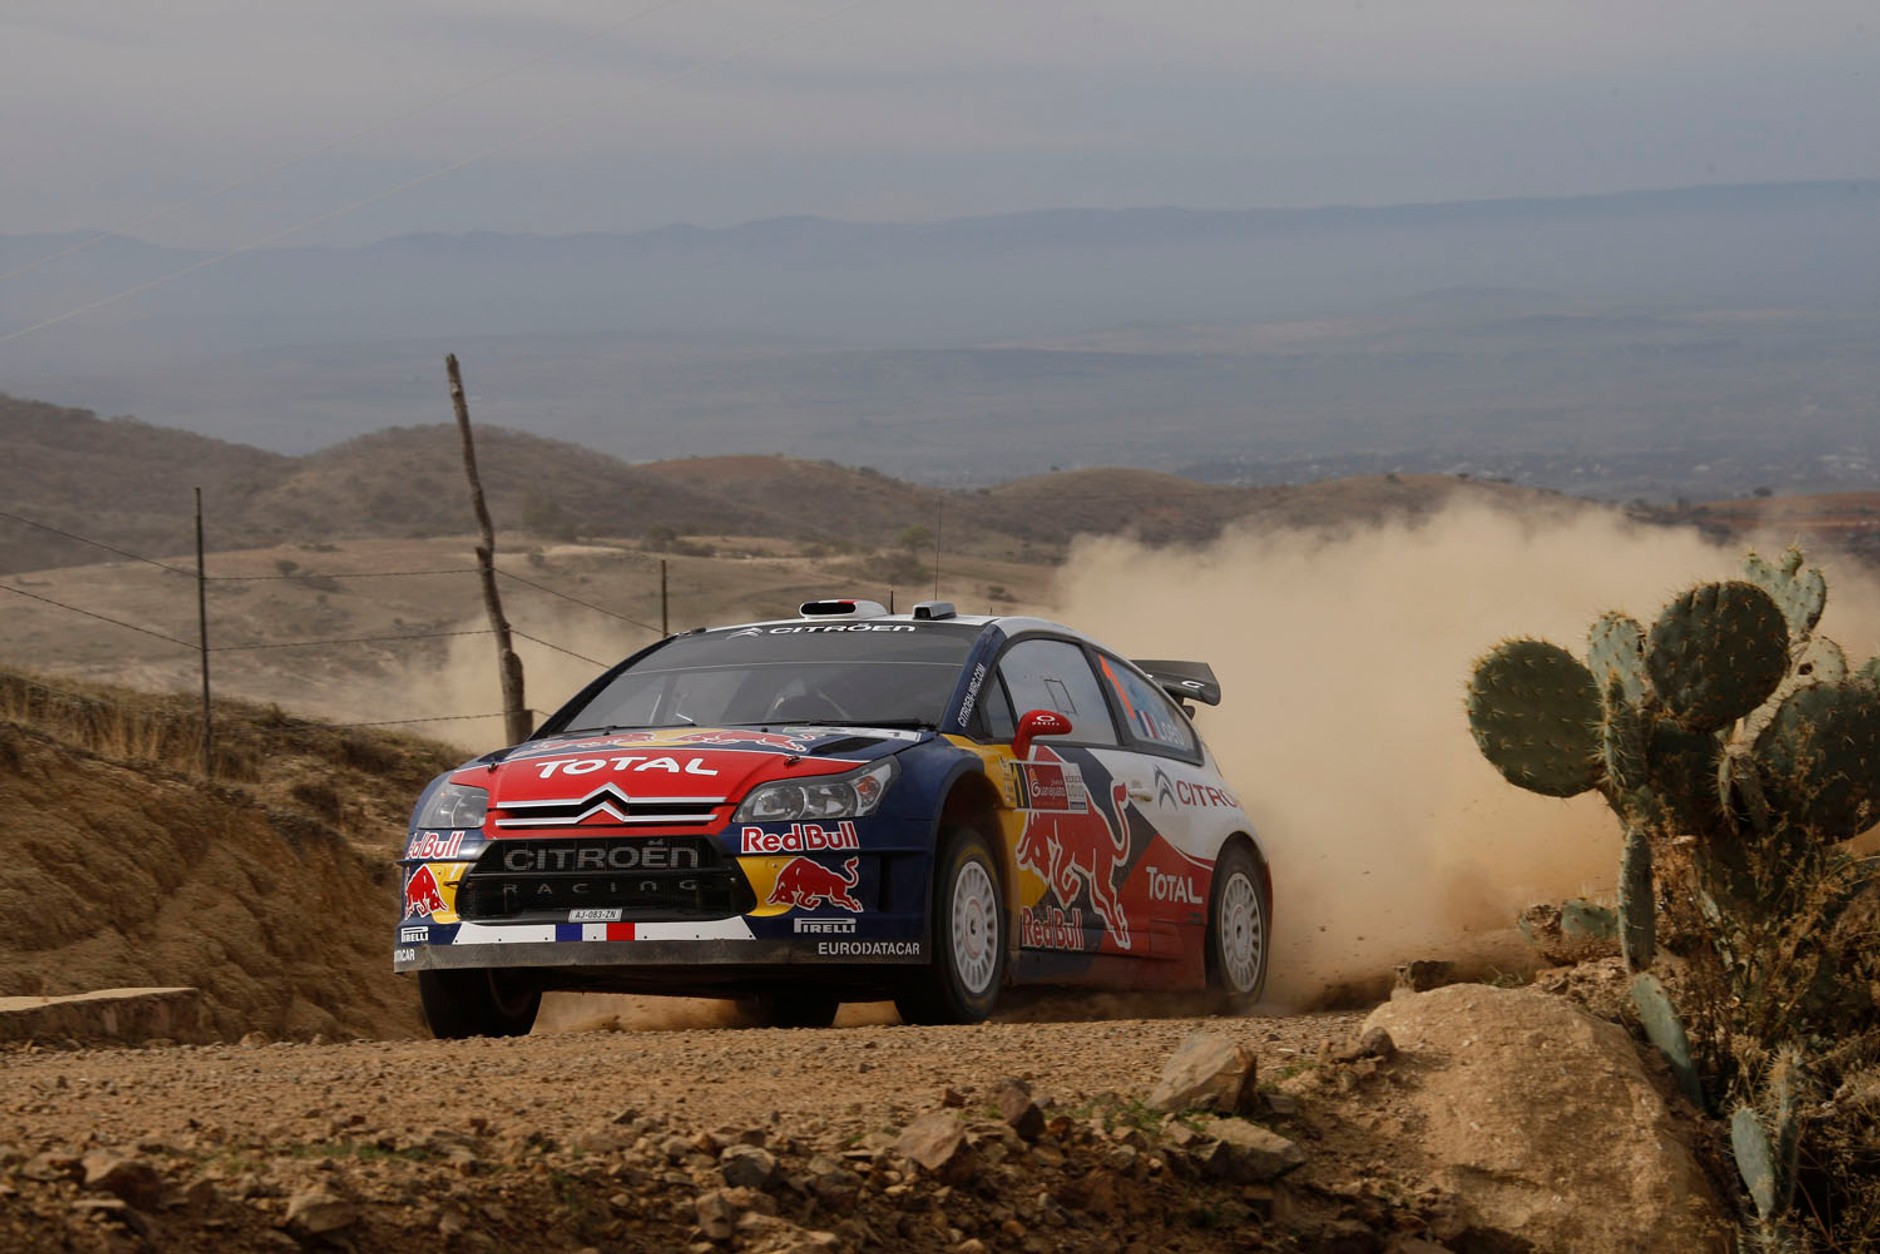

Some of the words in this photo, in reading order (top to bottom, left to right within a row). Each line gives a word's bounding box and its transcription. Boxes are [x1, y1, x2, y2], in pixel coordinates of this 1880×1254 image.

[535, 756, 719, 780] TOTAL
[421, 830, 466, 859] Bull
[741, 823, 804, 853] Red
[803, 821, 860, 850] Bull
[504, 838, 699, 871] CITROËN
[503, 879, 698, 895] RACING
[1146, 866, 1203, 904] TOTAL
[401, 926, 428, 943] PIRELLI
[794, 917, 857, 933] PIRELLI
[1022, 900, 1054, 948] Red
[1053, 907, 1085, 950] Bull
[818, 942, 920, 955] EURODATACAR
